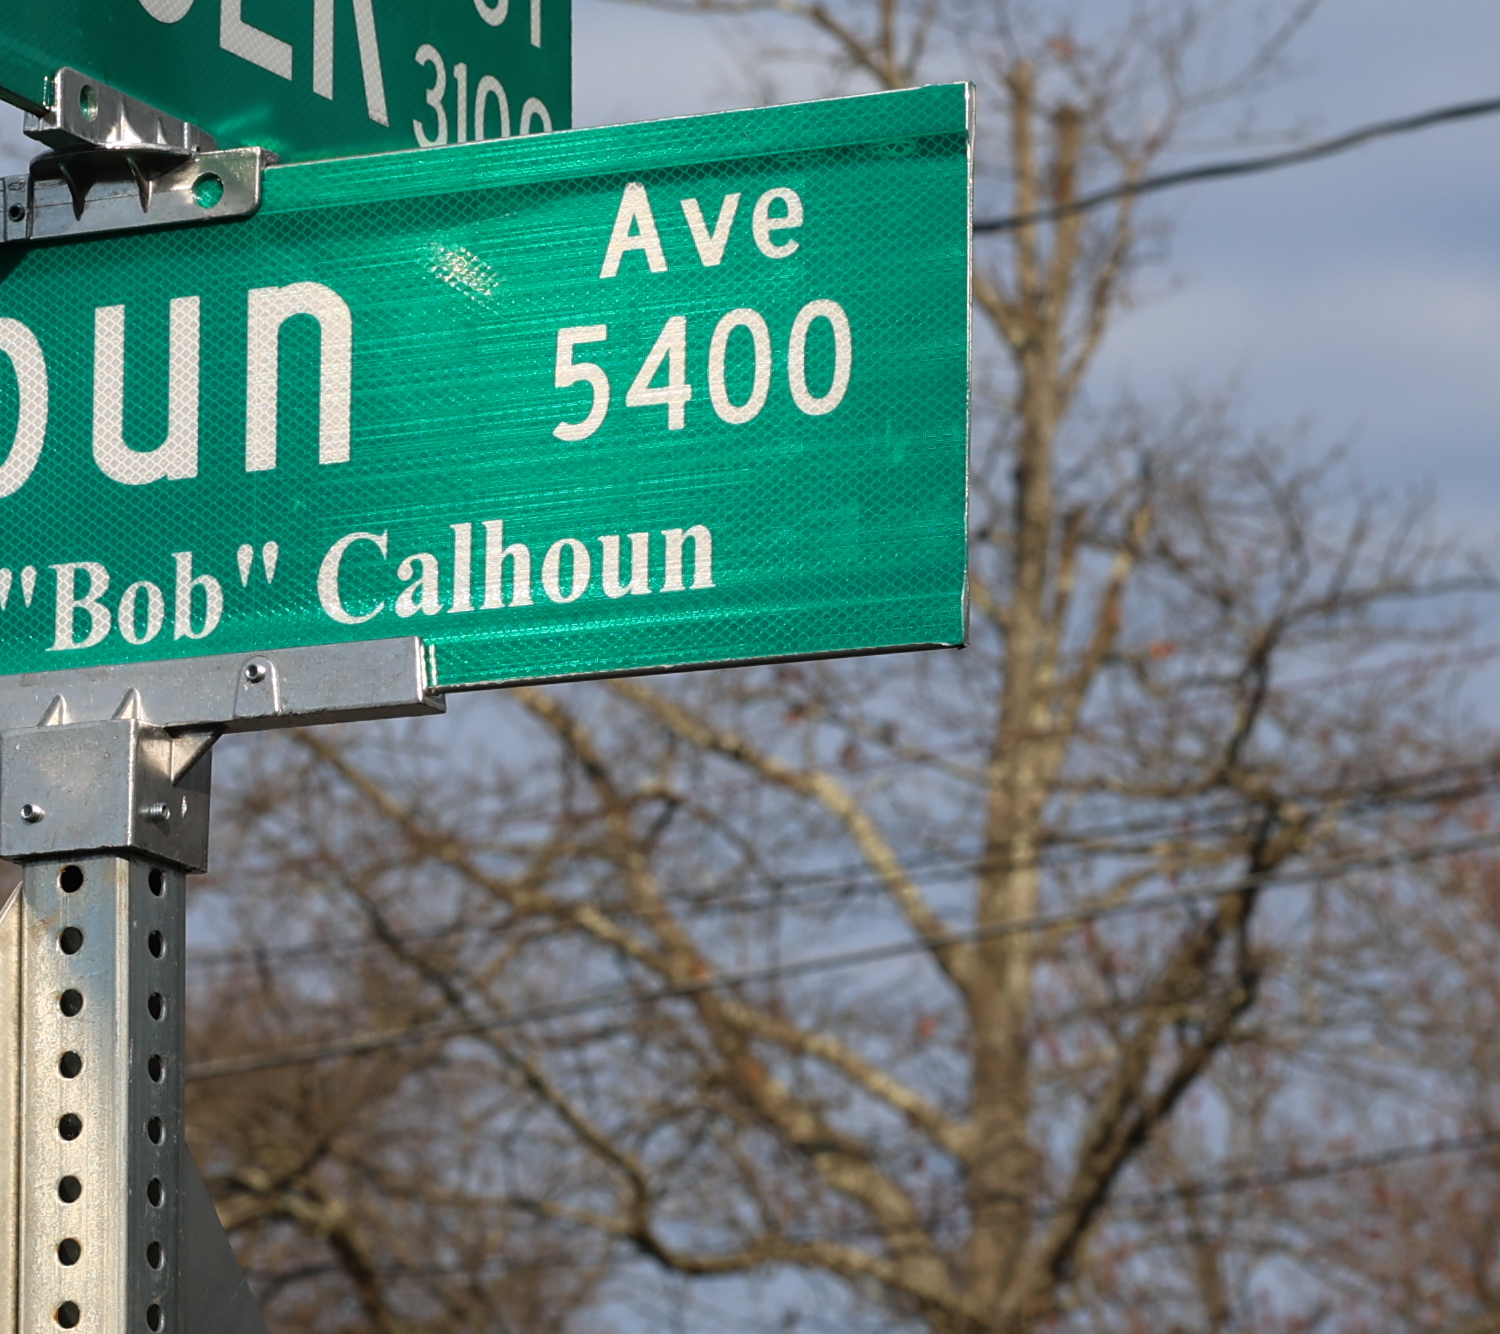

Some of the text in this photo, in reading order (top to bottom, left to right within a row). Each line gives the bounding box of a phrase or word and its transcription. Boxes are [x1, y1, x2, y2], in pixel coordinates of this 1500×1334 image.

[598, 181, 805, 280] Ave
[552, 297, 854, 443] 5400
[315, 518, 717, 627] Calhoun
